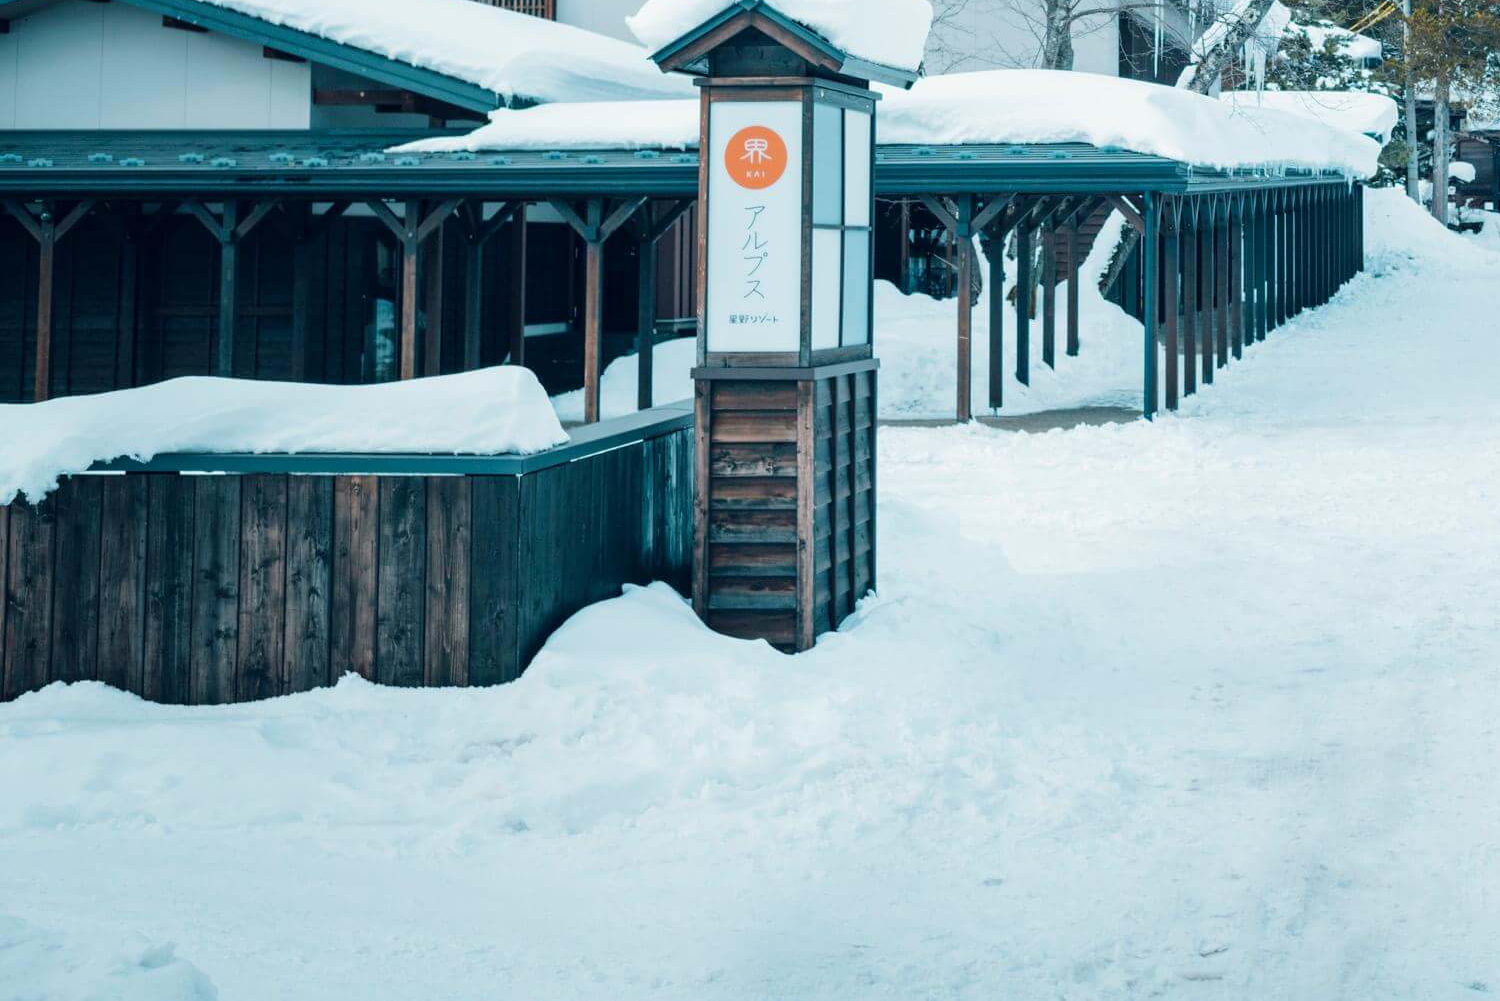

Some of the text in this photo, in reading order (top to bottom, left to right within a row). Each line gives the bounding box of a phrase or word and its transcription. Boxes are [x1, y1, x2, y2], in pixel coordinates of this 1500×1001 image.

[739, 138, 773, 165] 界
[746, 170, 766, 178] KAI
[742, 205, 769, 300] アルプス
[728, 313, 779, 325] 星野リゾート
